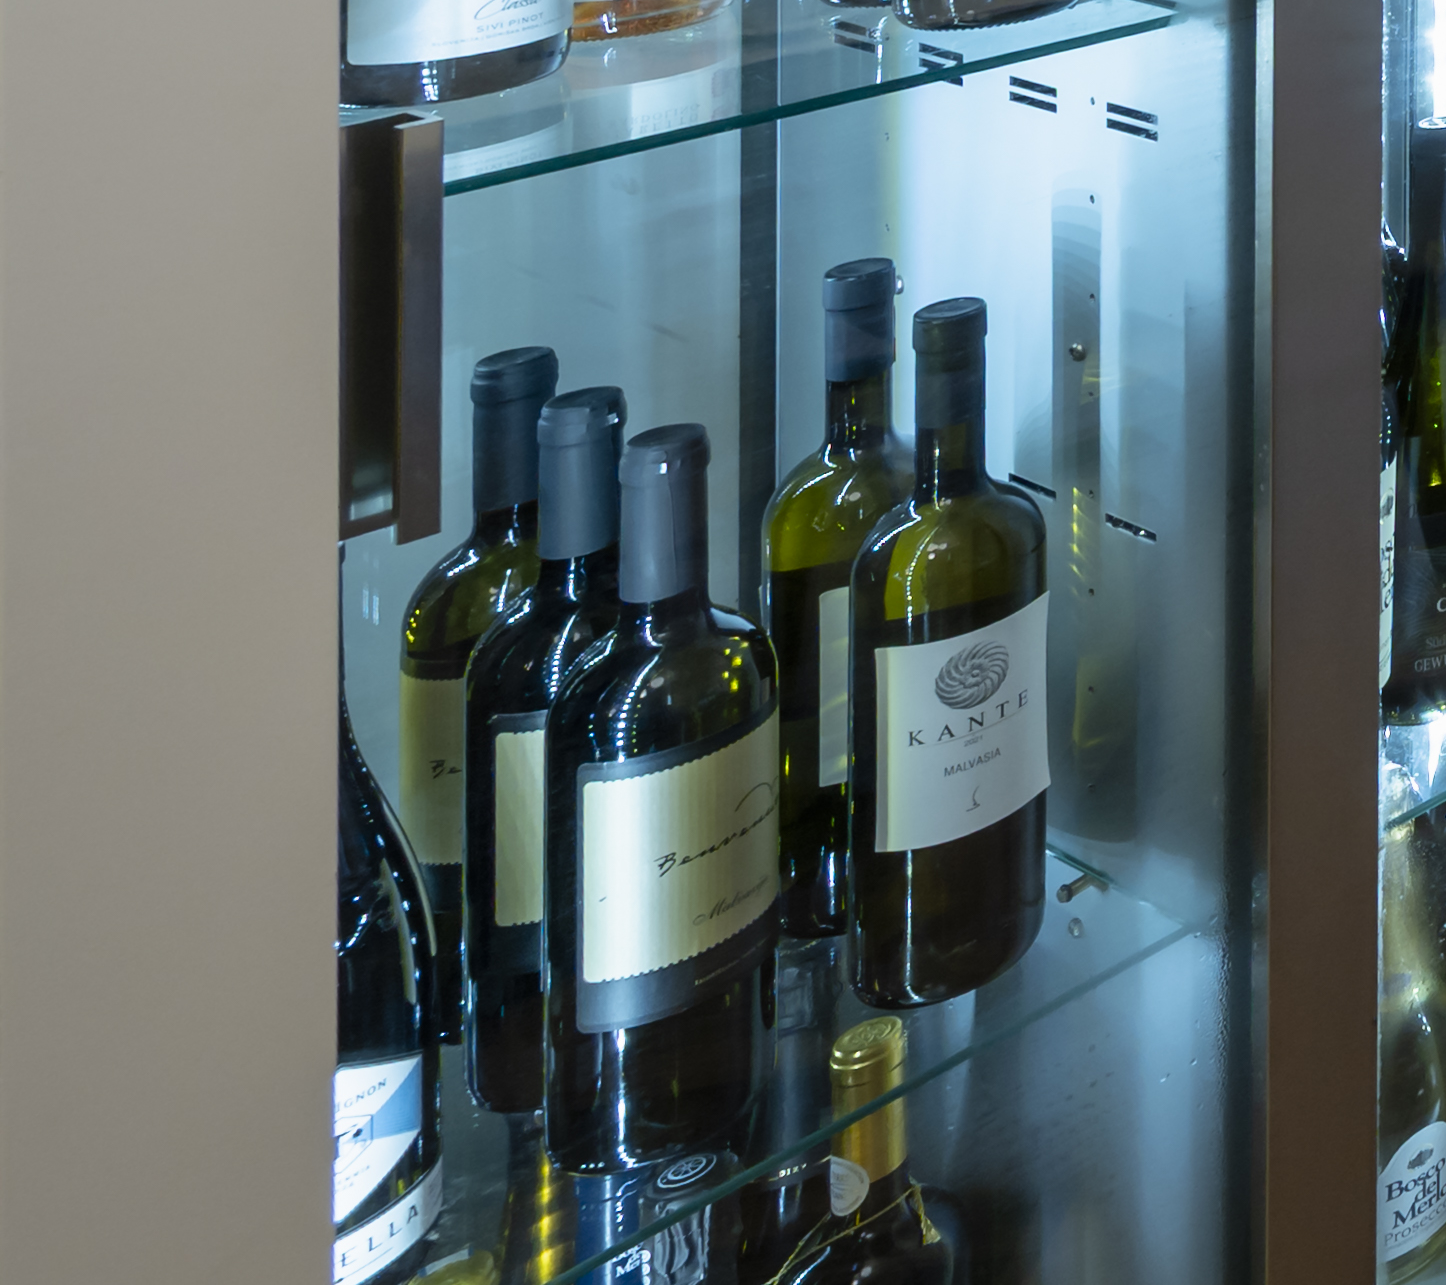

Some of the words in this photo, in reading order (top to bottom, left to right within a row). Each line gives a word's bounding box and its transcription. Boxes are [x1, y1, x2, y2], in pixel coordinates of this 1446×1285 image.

[476, 20, 506, 34] SIVI
[509, 11, 545, 29] PINOT
[908, 688, 1029, 747] KANTE
[943, 747, 1002, 778] MALVASIA
[1414, 1170, 1441, 1202] del
[341, 1204, 419, 1268] ELLA
